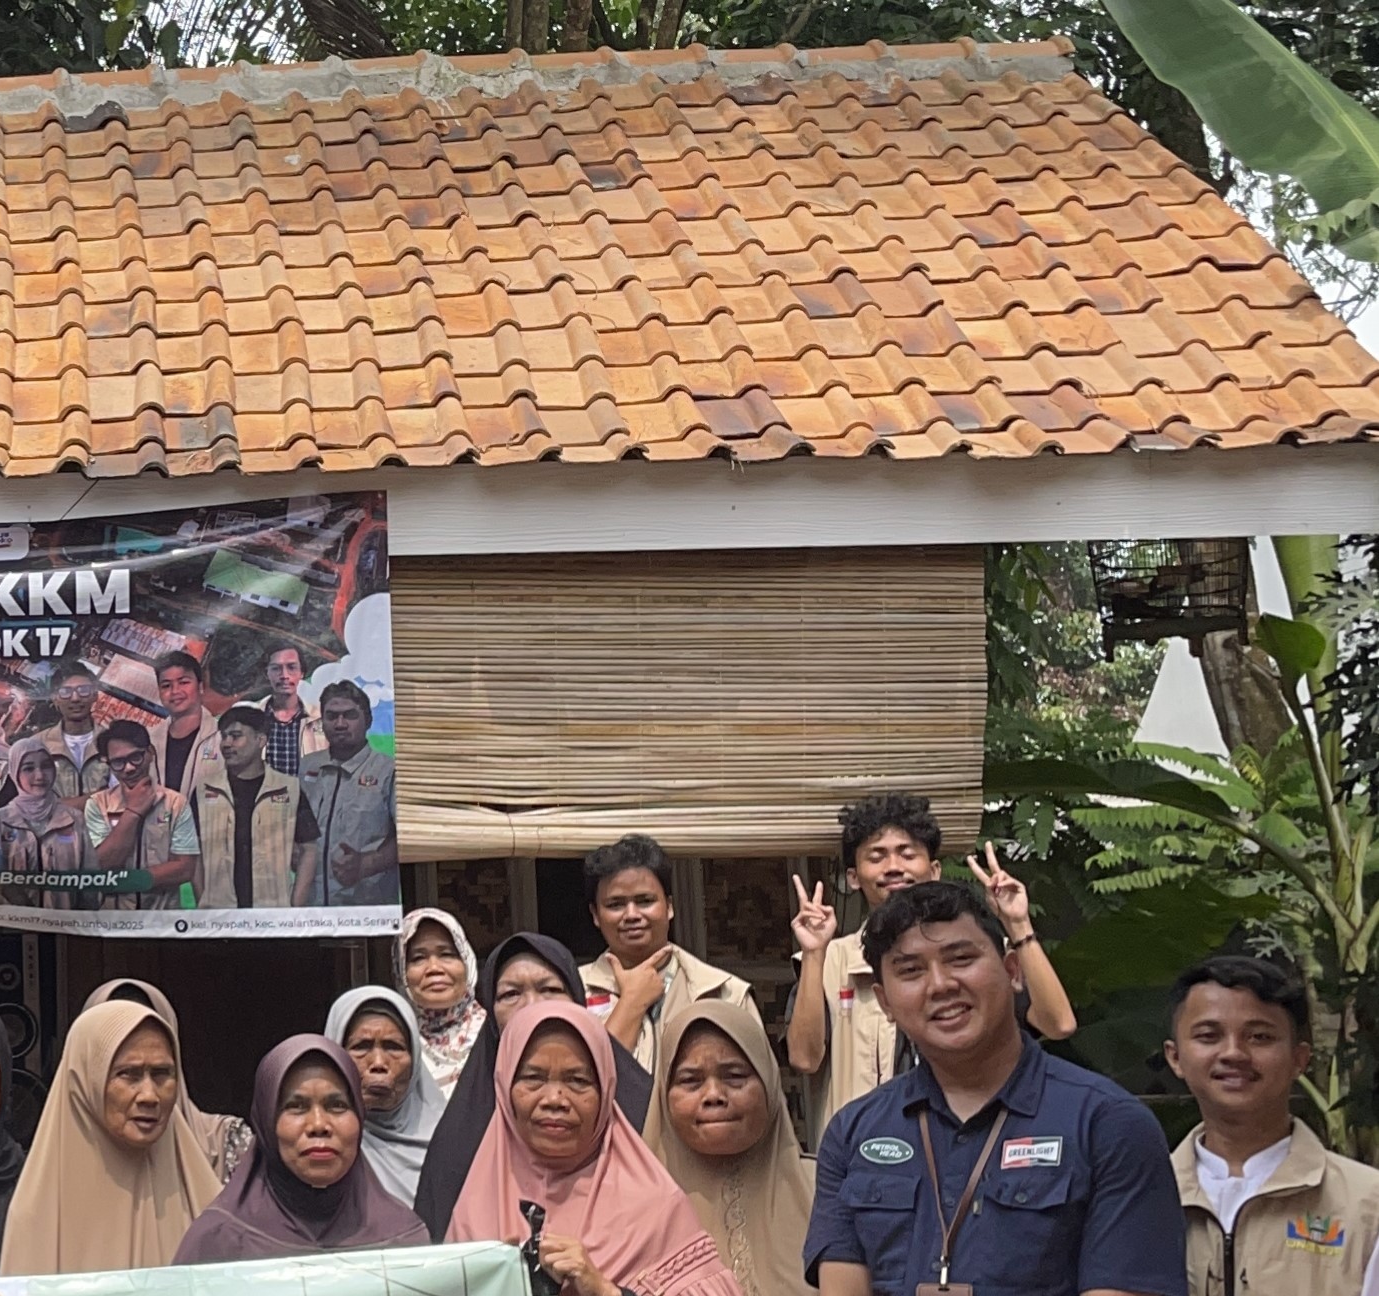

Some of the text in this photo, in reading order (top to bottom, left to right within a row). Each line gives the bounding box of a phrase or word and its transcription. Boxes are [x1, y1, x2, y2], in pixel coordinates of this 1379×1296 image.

[36, 627, 71, 657] 17
[0, 871, 128, 890] Berdampak"
[190, 920, 209, 929] kel.
[211, 920, 253, 930] nyapah,
[255, 920, 276, 929] kec.
[279, 918, 335, 929] walantaka,
[338, 917, 361, 927] kota
[871, 1143, 899, 1151] PETROL
[879, 1150, 903, 1158] HEAD
